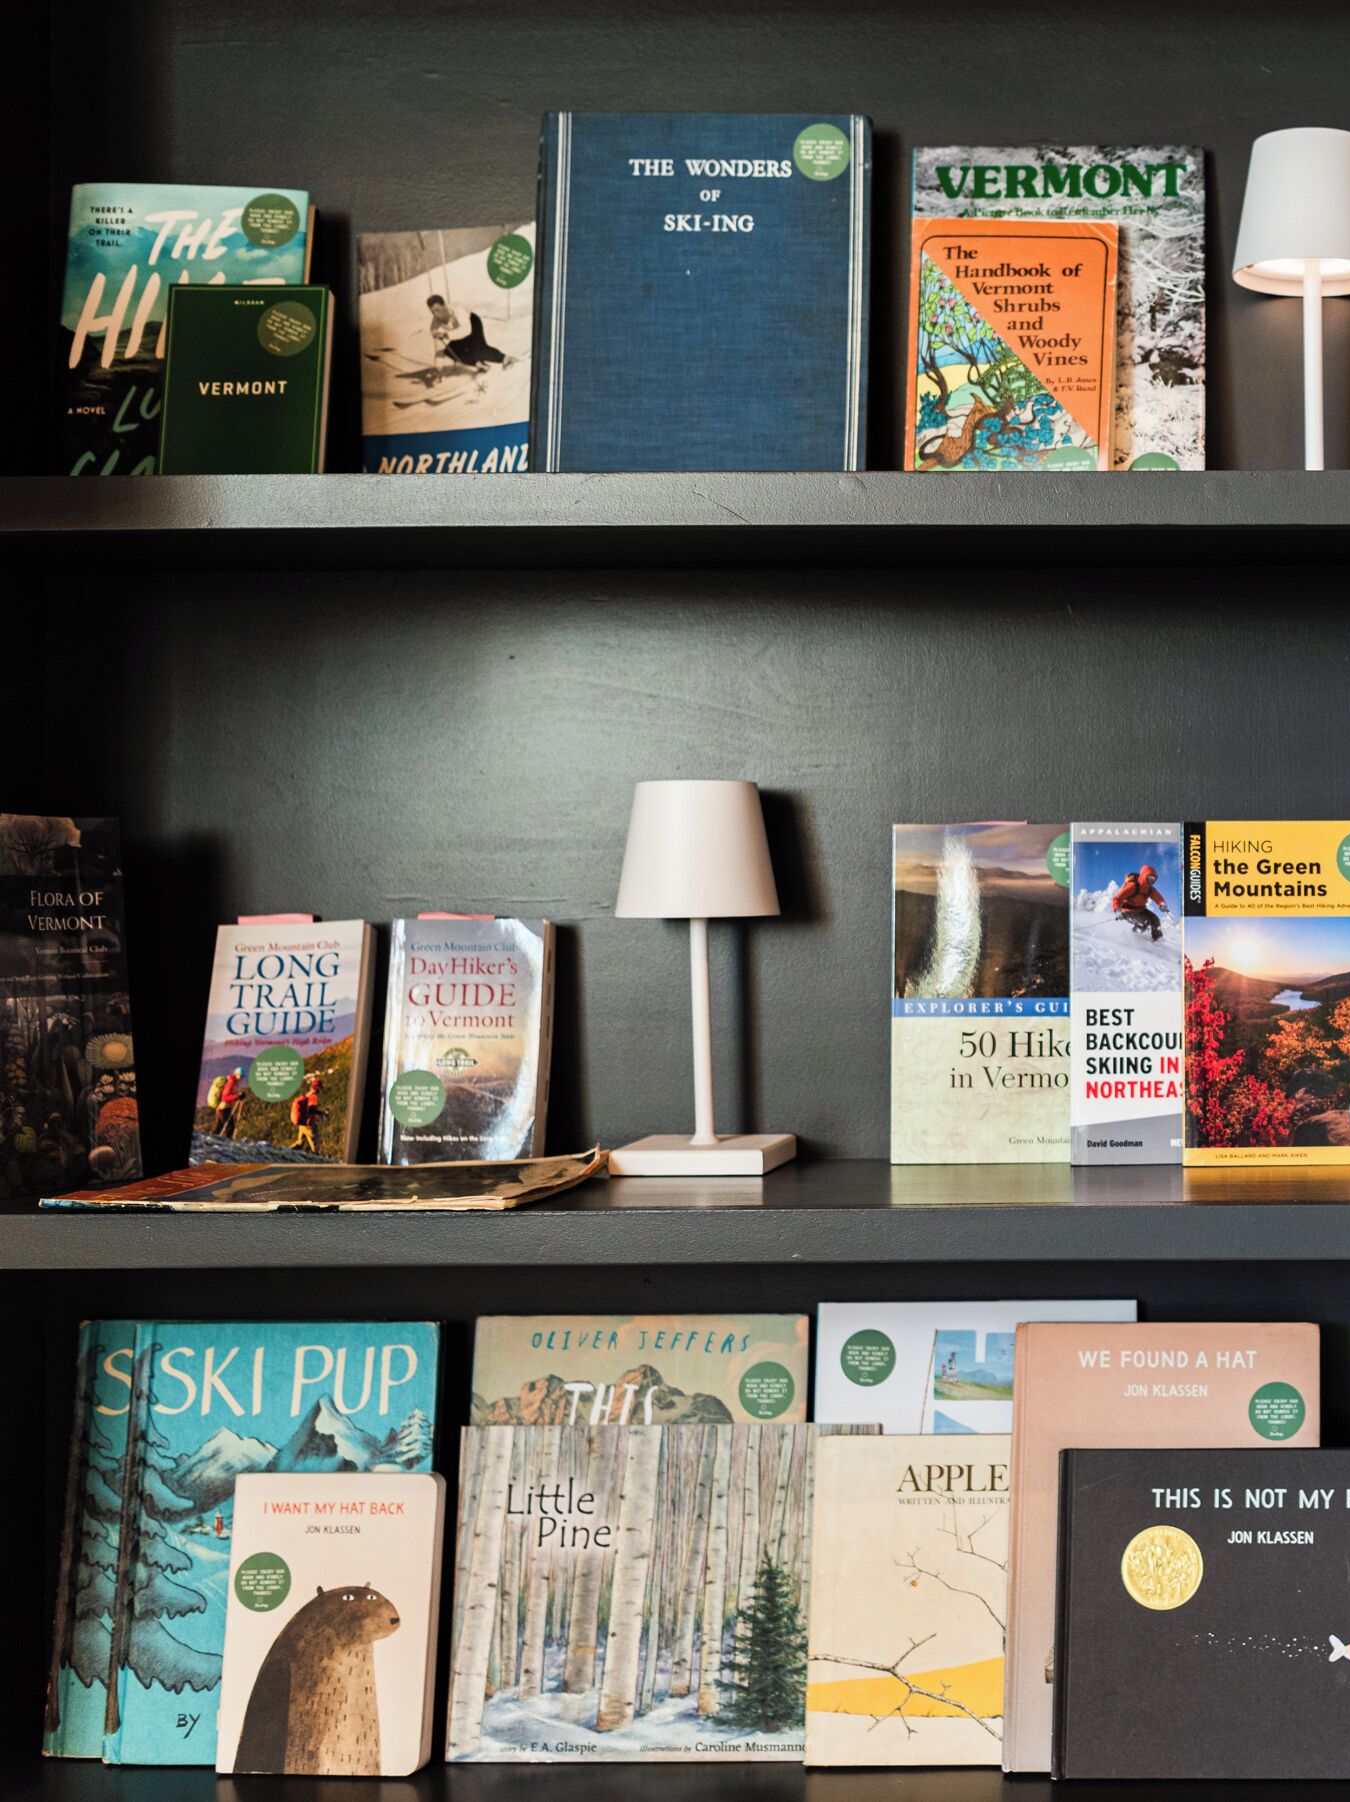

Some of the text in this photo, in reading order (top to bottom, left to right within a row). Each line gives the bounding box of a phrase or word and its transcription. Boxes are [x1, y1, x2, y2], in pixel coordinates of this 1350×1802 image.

[629, 159, 792, 178] THE WONDERS
[935, 163, 1187, 199] VERMONT
[699, 190, 722, 202] OF
[663, 214, 755, 232] SKI-ING
[144, 207, 244, 265] THE
[944, 246, 978, 260] The
[955, 263, 1083, 279] Handbook of
[972, 282, 1055, 296] Vermont
[993, 298, 1061, 313] Shrubs
[1007, 316, 1044, 331] and
[1018, 333, 1082, 351] Woody
[1032, 352, 1088, 366] Vines
[198, 381, 288, 395] VERMONT
[77, 406, 106, 414] NOVEL
[1080, 828, 1173, 836] APPALACHIAN
[1213, 840, 1273, 853] HIKING
[1213, 858, 1322, 875] the Green
[1213, 881, 1328, 898] Mountains
[30, 890, 104, 907] FLORA OF
[27, 914, 107, 931] VERMONT
[317, 941, 341, 950] Club
[444, 942, 493, 952] Mountain
[233, 952, 340, 980] LONG
[410, 956, 518, 978] Day Hiker's
[230, 982, 338, 1009] TRAIL
[408, 983, 517, 1008] GUIDE
[904, 1001, 1024, 1014] EXPLORER'S
[226, 1009, 336, 1036] GUIDE
[405, 1011, 516, 1028] to Vermont
[1086, 1008, 1135, 1026] BEST
[959, 1031, 997, 1059] 50
[1086, 1056, 1179, 1075] SKIING IN
[950, 1066, 1069, 1089] in Vermo
[1008, 1137, 1034, 1145] Green
[1087, 1139, 1143, 1148] David Goodman
[532, 1330, 751, 1354] OLIVER JEFFERS
[1078, 1350, 1258, 1368] WE FOUND A HAT
[154, 1345, 419, 1418] SKI PUP
[1124, 1384, 1208, 1397] JON KLASSEN
[896, 1464, 1010, 1492] APPLE
[507, 1477, 595, 1515] Little
[1151, 1488, 1202, 1509] THIS
[1213, 1488, 1233, 1509] IS
[1244, 1488, 1287, 1509] NOT
[1298, 1489, 1335, 1509] MY
[263, 1502, 405, 1514] I WANT MY HAT BACK
[305, 1525, 361, 1535] JON KLASSEN
[537, 1517, 612, 1549] Pine
[1227, 1530, 1314, 1544] JON KLASSEN
[176, 1712, 201, 1739] BY
[555, 1741, 598, 1755] Glaspie
[695, 1742, 742, 1752] Caroline
